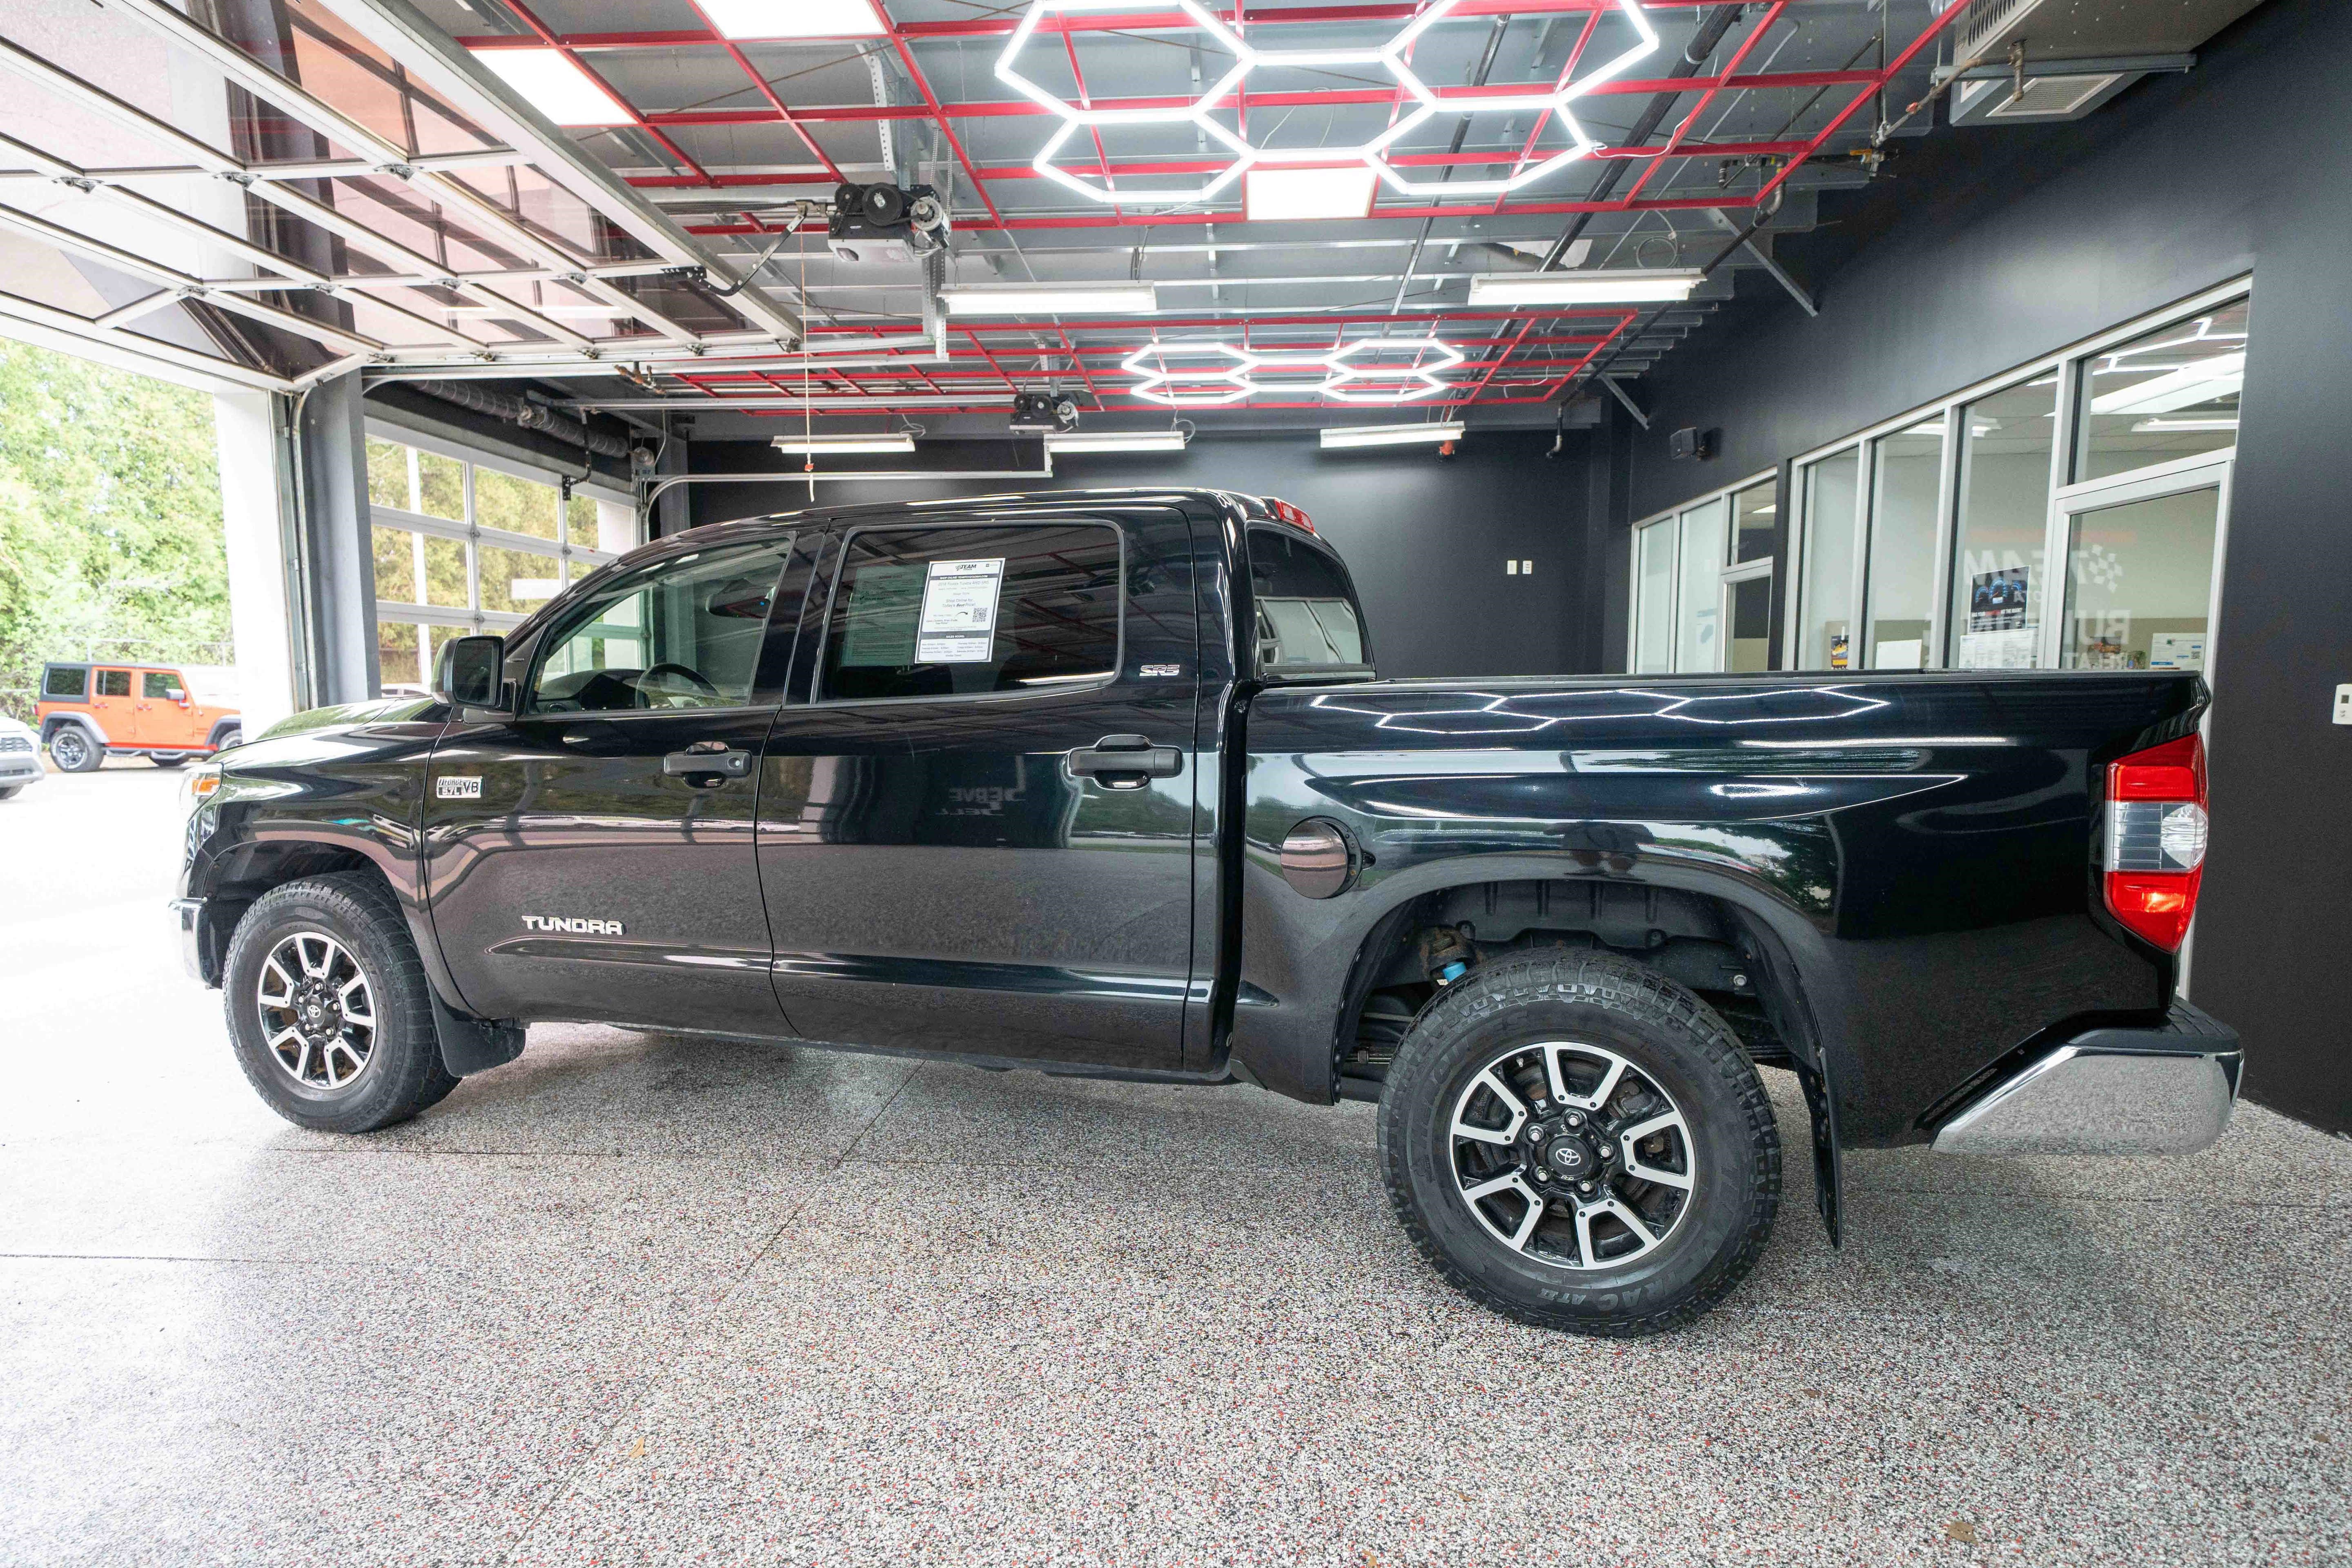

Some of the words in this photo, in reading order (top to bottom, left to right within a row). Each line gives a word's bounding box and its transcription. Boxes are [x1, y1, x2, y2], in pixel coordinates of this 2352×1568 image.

[1139, 664, 1180, 676] SR5
[463, 782, 479, 793] V8
[521, 915, 625, 935] TUNDRA
